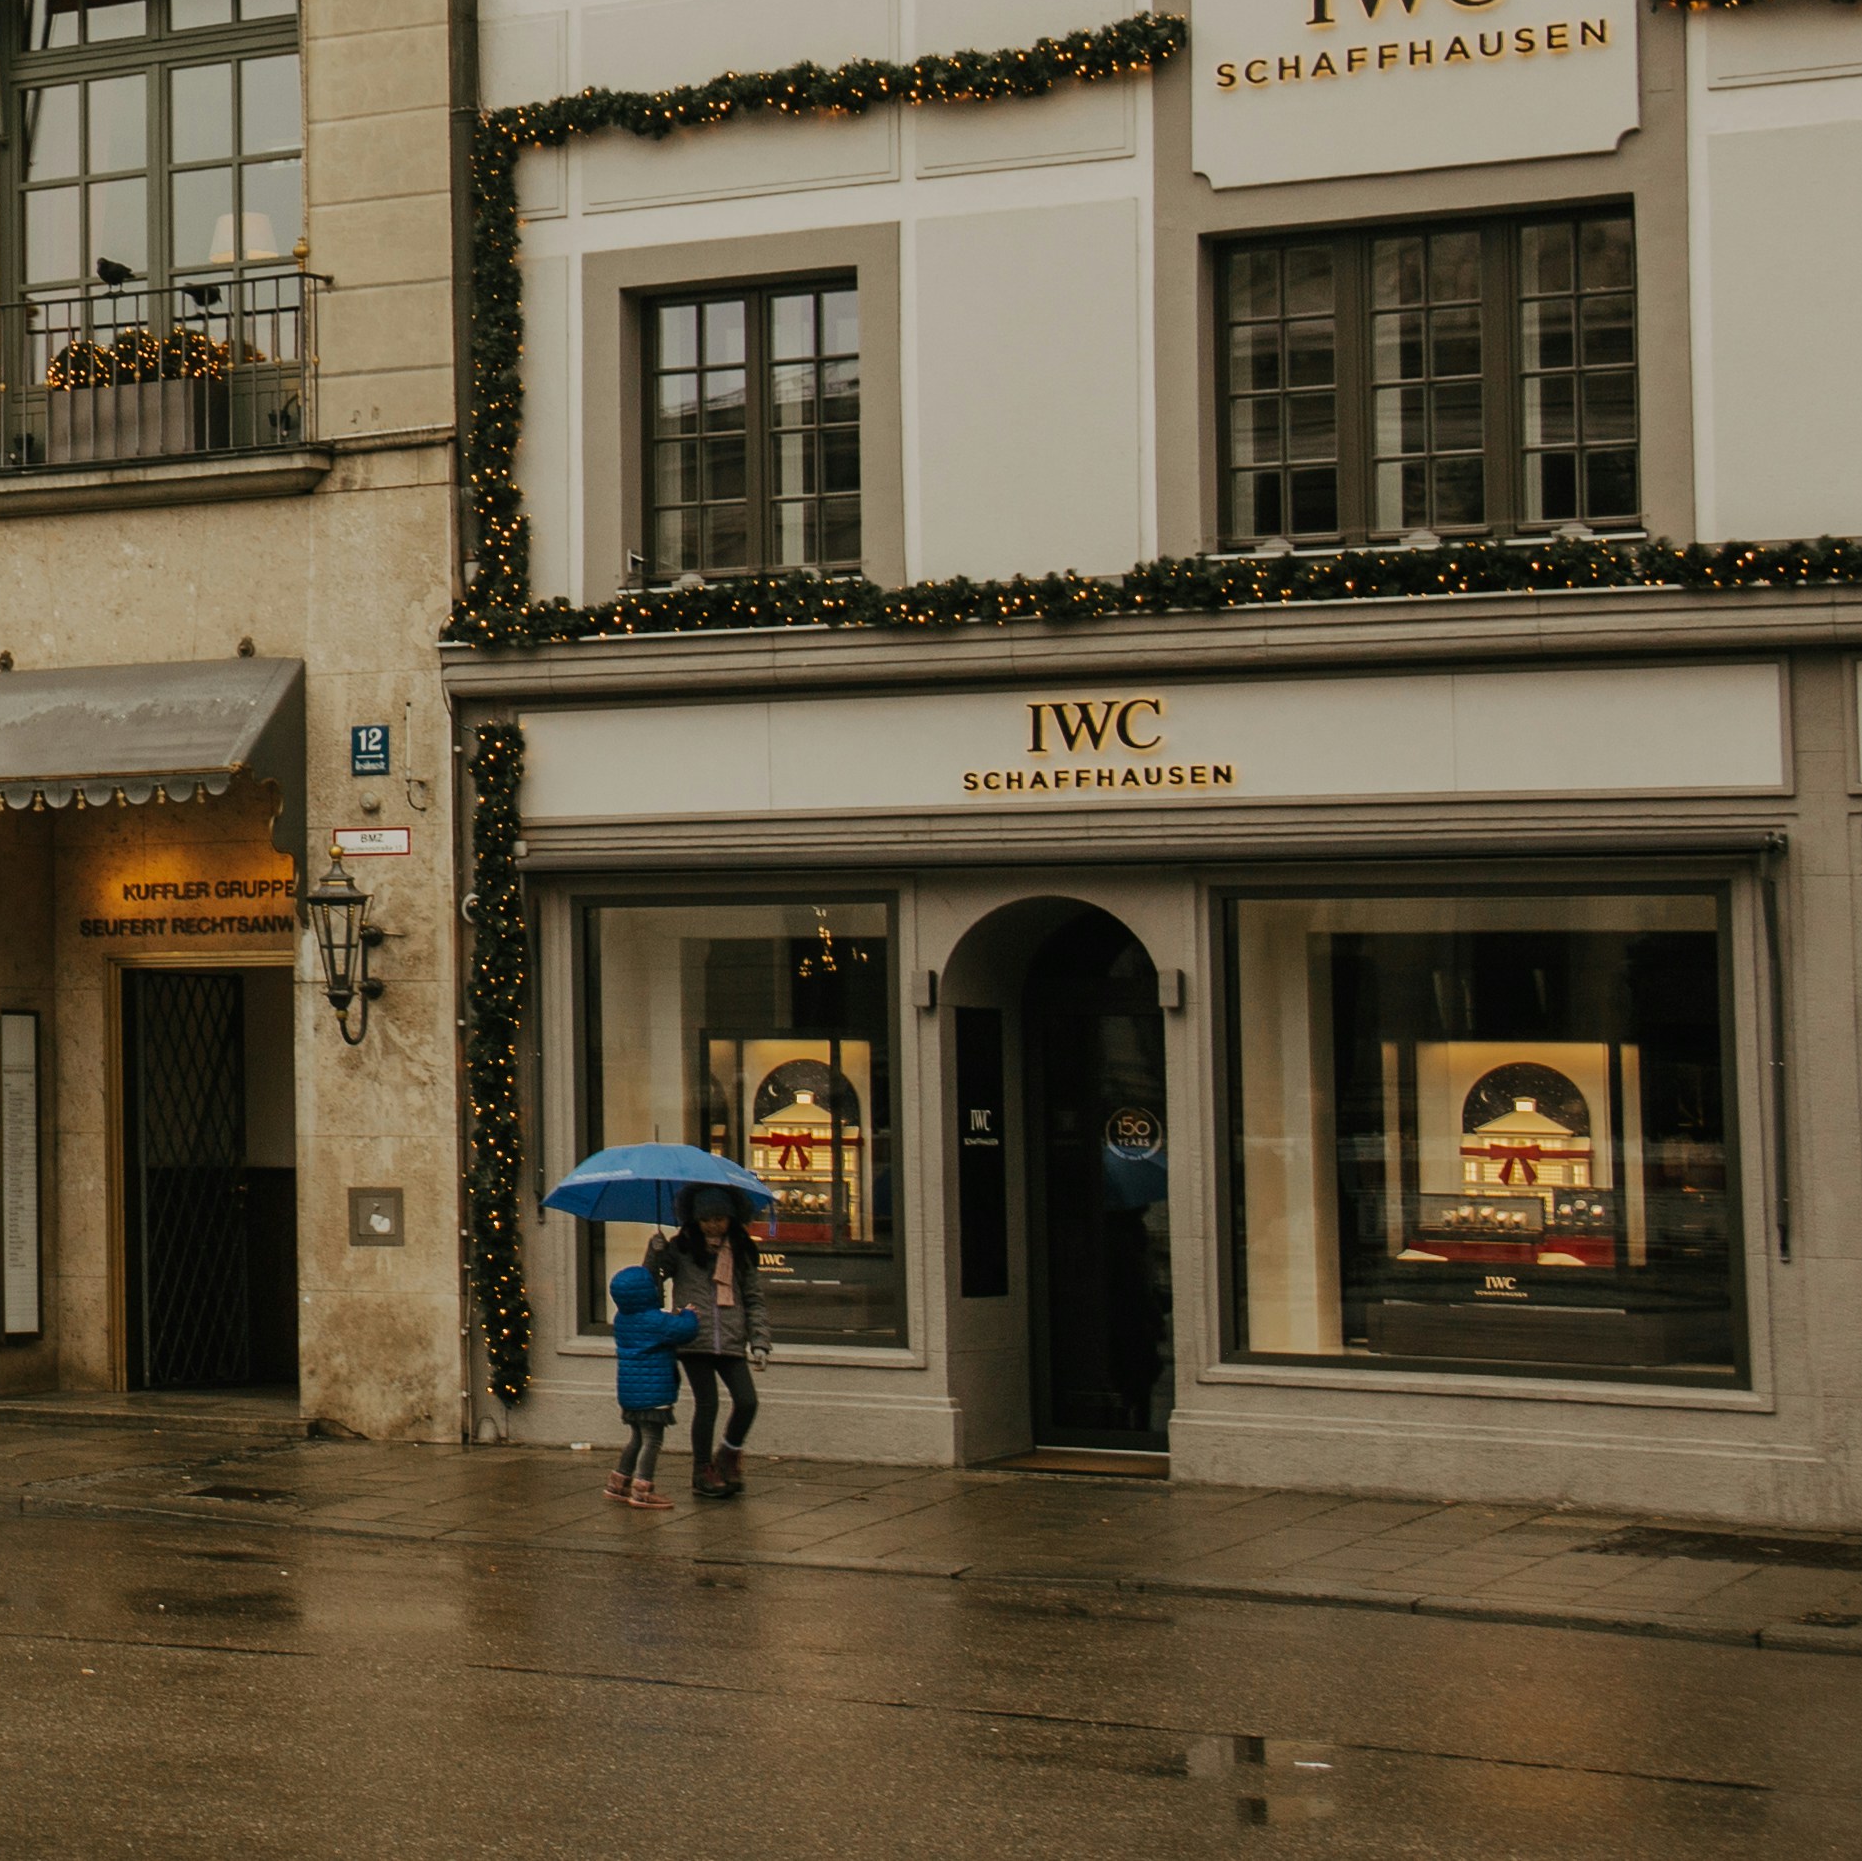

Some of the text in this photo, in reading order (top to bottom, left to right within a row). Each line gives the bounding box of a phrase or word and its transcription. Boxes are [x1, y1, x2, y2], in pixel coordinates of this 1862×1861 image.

[1216, 19, 1607, 88] SCHAFFHAUSEN
[1026, 698, 1161, 753] IWC
[358, 727, 383, 752] 12
[963, 764, 1233, 791] SCHAFFHAUSEN
[122, 880, 295, 902] KUFFLER GRUPPE
[79, 916, 168, 938] SEUFERT
[970, 1109, 992, 1132] IWC
[1117, 1116, 1151, 1137] 150
[1117, 1138, 1150, 1147] YEARS
[758, 1253, 786, 1266] IWC
[1485, 1275, 1517, 1290] IWC
